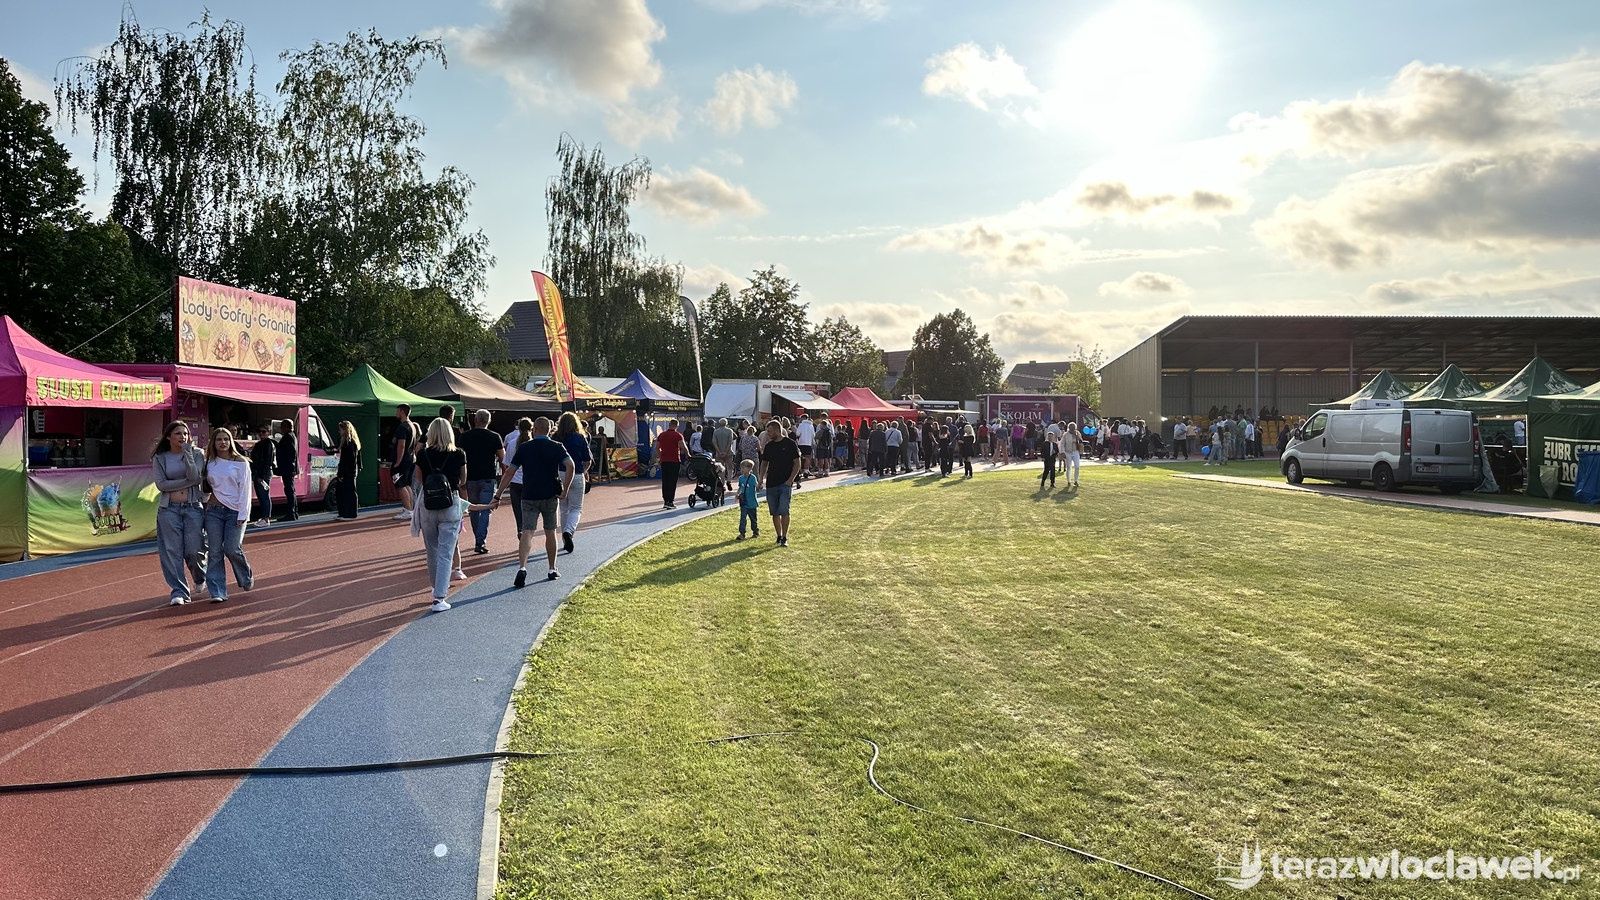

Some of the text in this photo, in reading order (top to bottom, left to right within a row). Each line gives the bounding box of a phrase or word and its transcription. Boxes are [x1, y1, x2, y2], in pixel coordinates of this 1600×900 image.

[182, 297, 296, 336] Lody Gofry Granita
[36, 376, 165, 404] SLUSH GRANITA
[1000, 411, 1042, 421] SKOLIM
